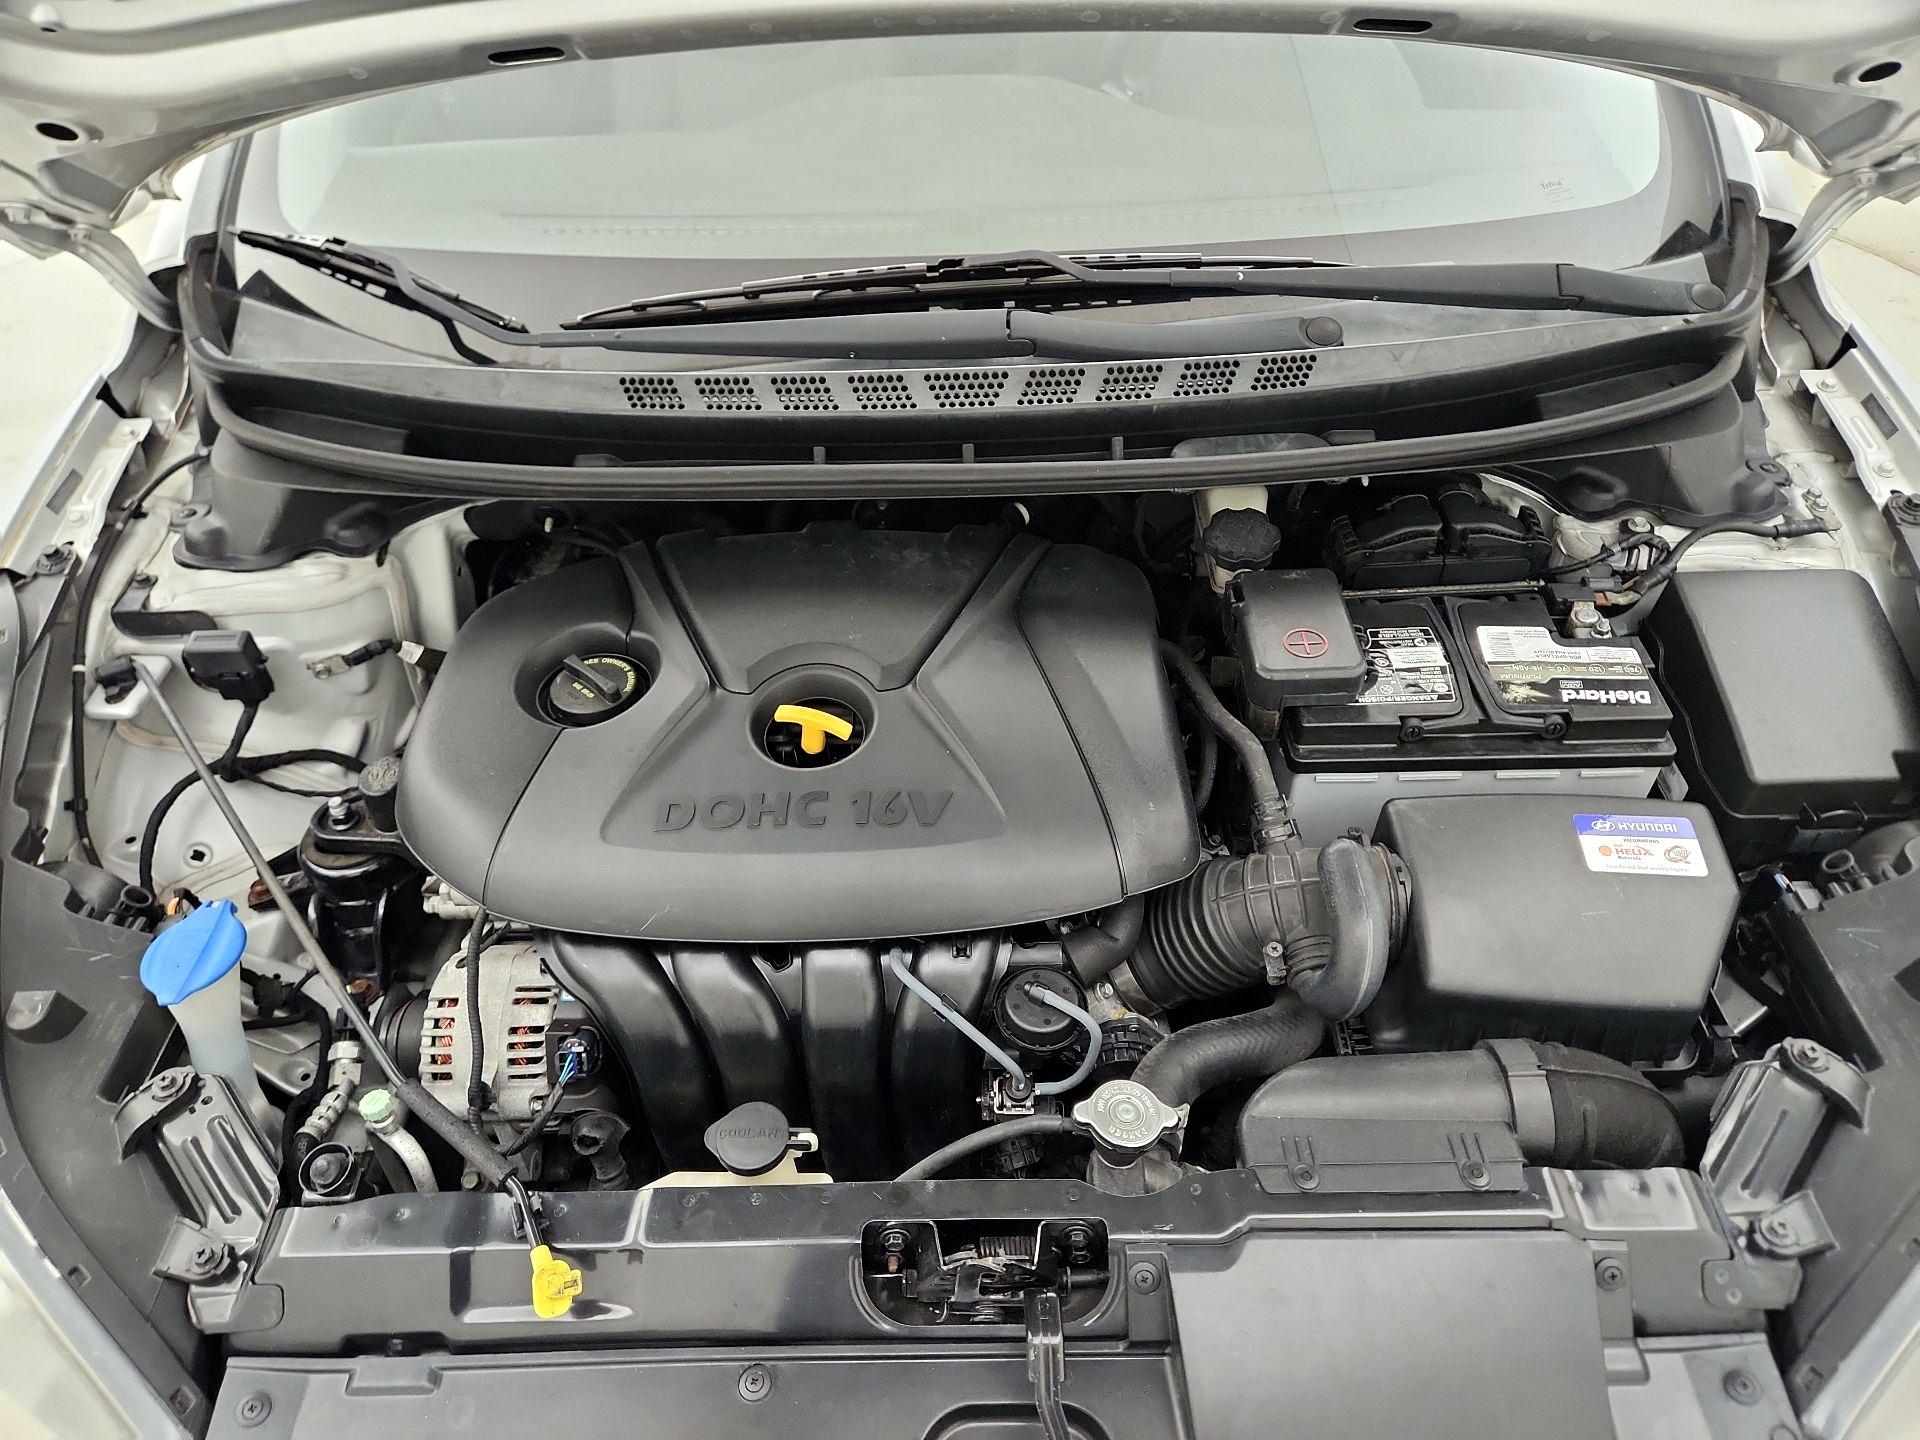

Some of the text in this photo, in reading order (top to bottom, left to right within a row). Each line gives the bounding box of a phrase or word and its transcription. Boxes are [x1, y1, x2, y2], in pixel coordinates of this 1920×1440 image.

[1560, 689, 1652, 704] DieHard
[654, 789, 954, 833] DOHC 16V
[1617, 822, 1678, 833] HYUNDAI
[1615, 846, 1654, 856] HELIX
